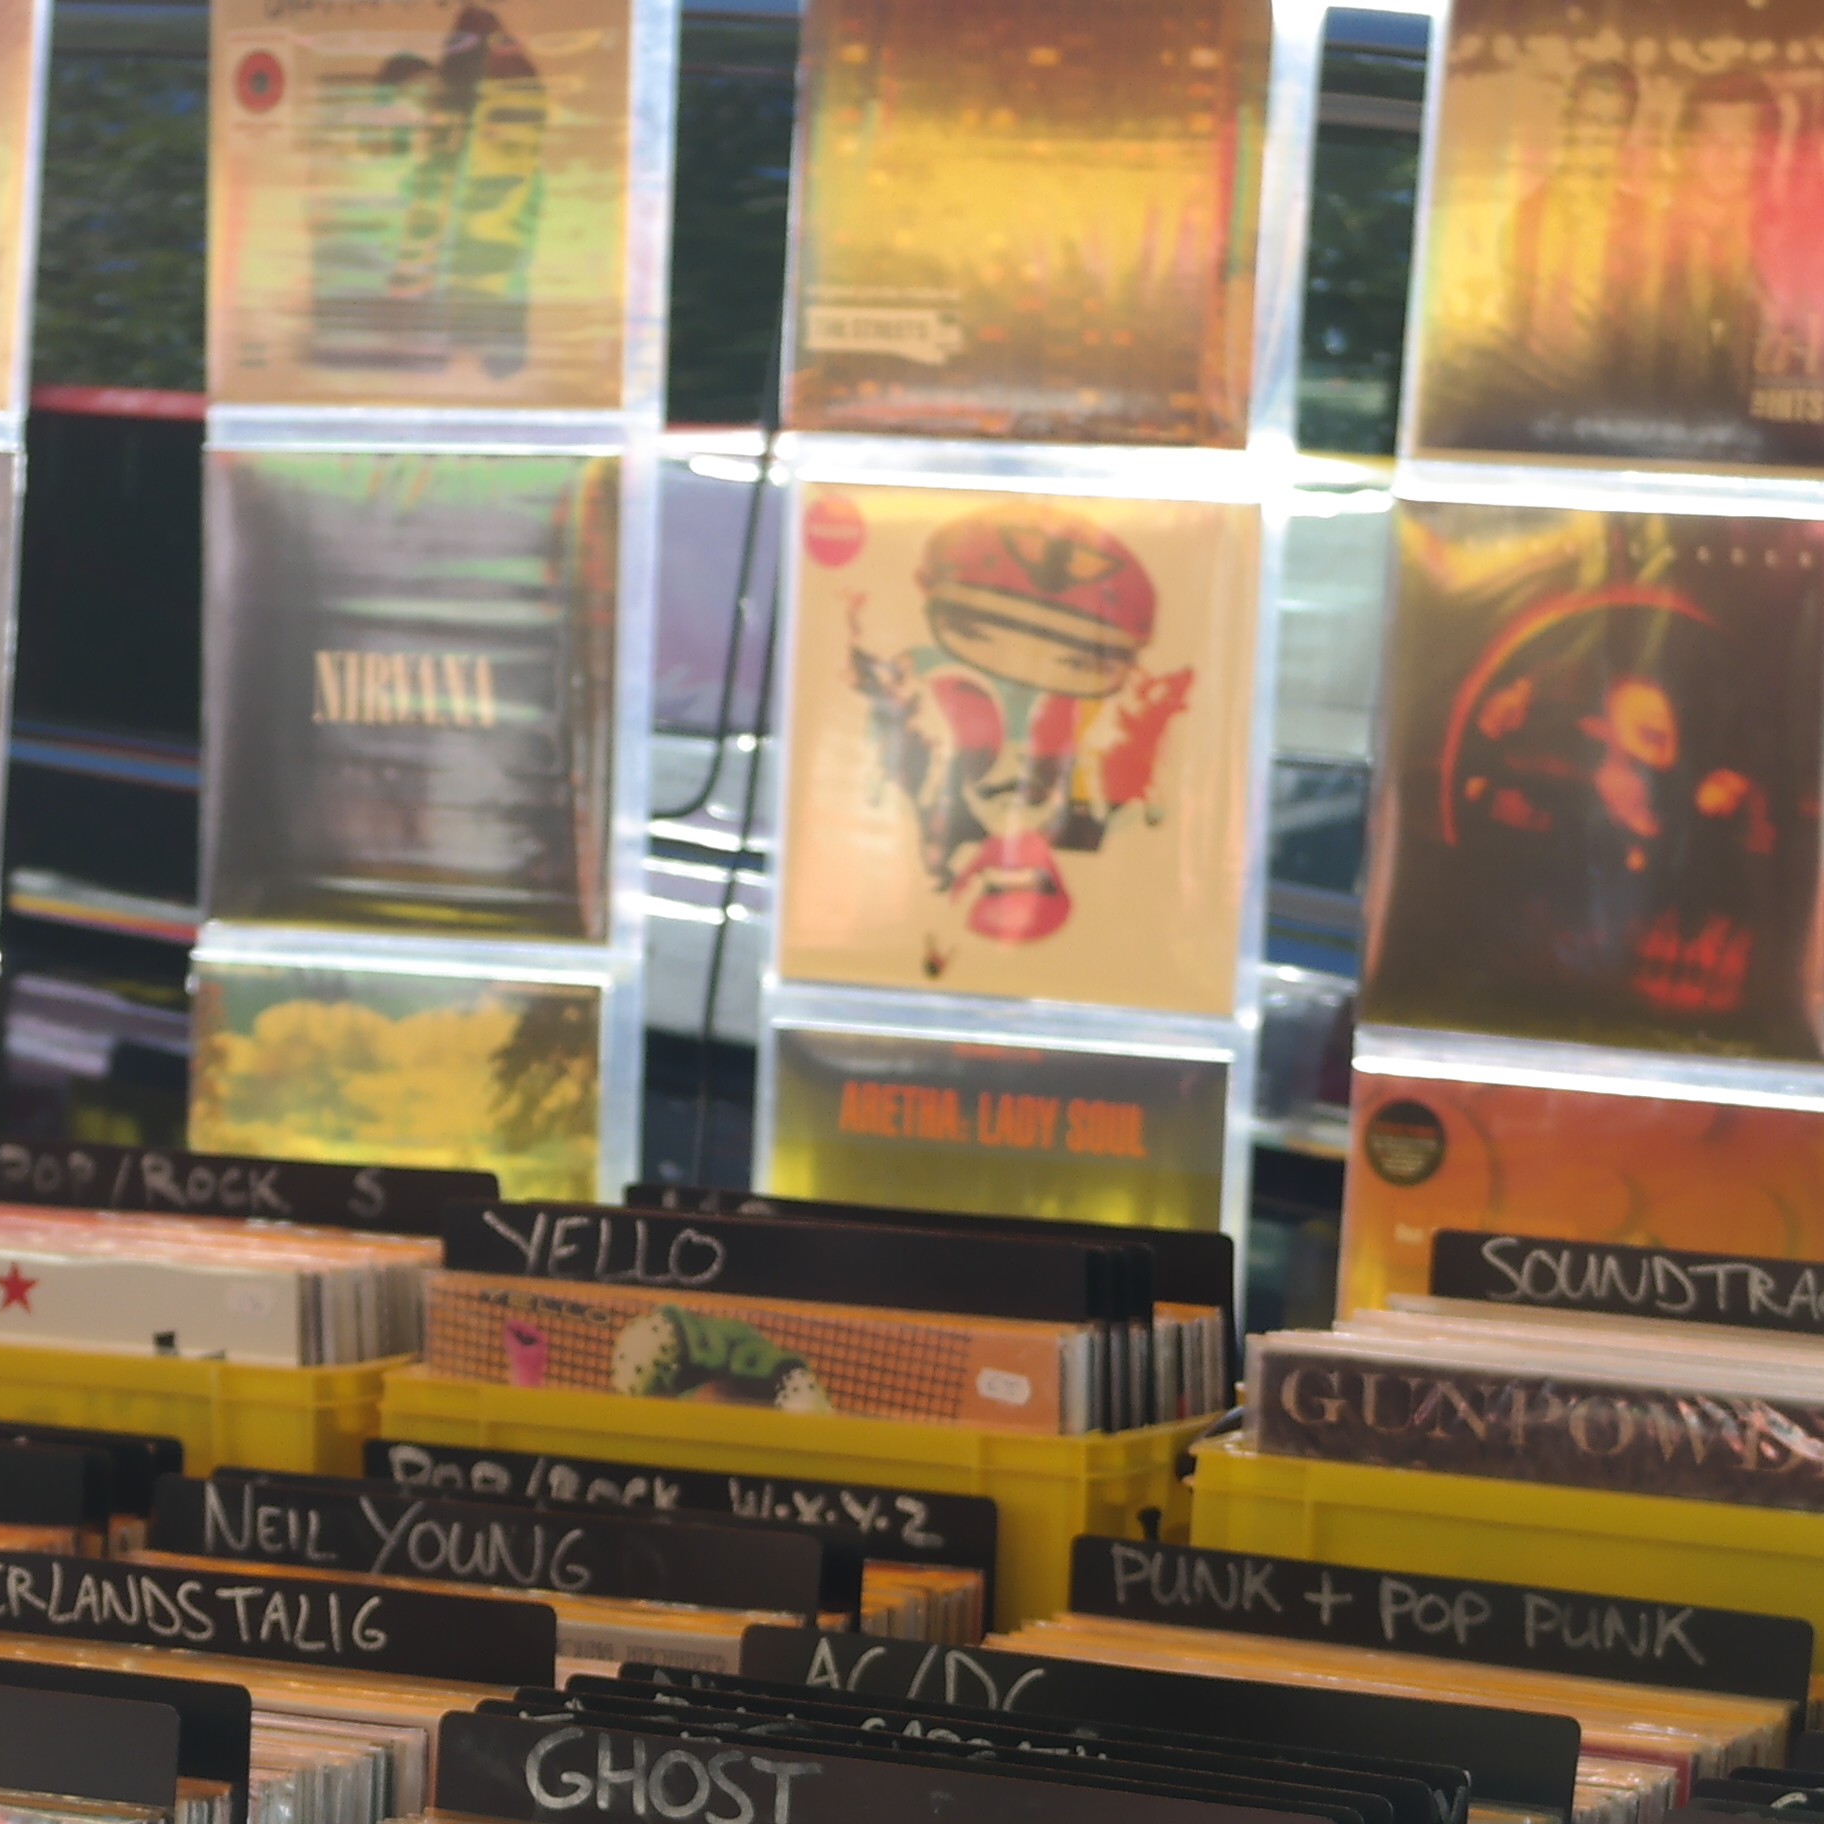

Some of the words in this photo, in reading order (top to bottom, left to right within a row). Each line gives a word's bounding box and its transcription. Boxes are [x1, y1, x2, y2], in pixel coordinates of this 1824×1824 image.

[312, 649, 497, 729] NIRVANA
[1067, 1097, 1149, 1160] SOUL
[481, 1207, 727, 1286] YELLO
[204, 1479, 339, 1562] NEIL
[359, 1494, 593, 1593] YOUNG
[1110, 1541, 1285, 1615] PUNK
[1379, 1579, 1492, 1645] POP
[1523, 1600, 1705, 1668] PUNK
[805, 1635, 1046, 1713] AC/DC
